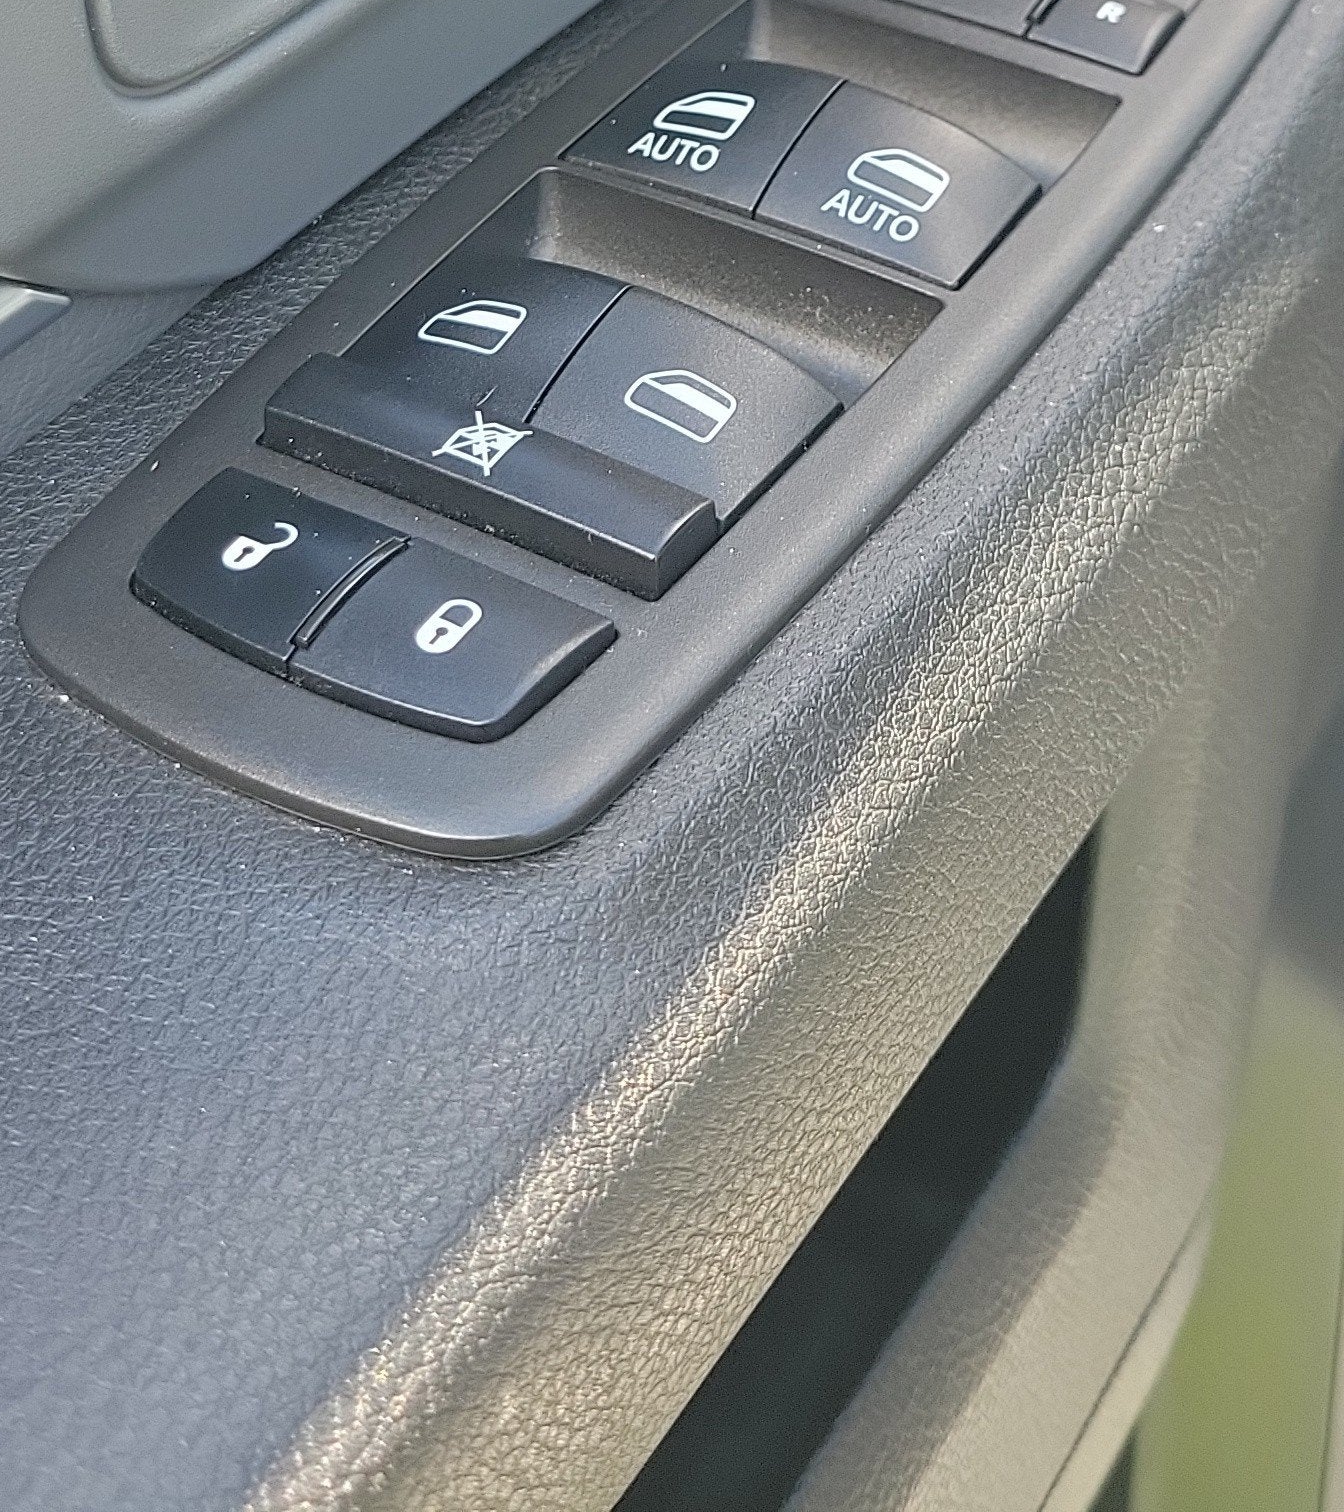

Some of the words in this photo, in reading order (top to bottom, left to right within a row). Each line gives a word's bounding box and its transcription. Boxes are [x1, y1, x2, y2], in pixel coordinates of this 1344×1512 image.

[1096, 0, 1127, 24] R
[627, 132, 721, 172] AUTO
[820, 189, 920, 242] AUTO
